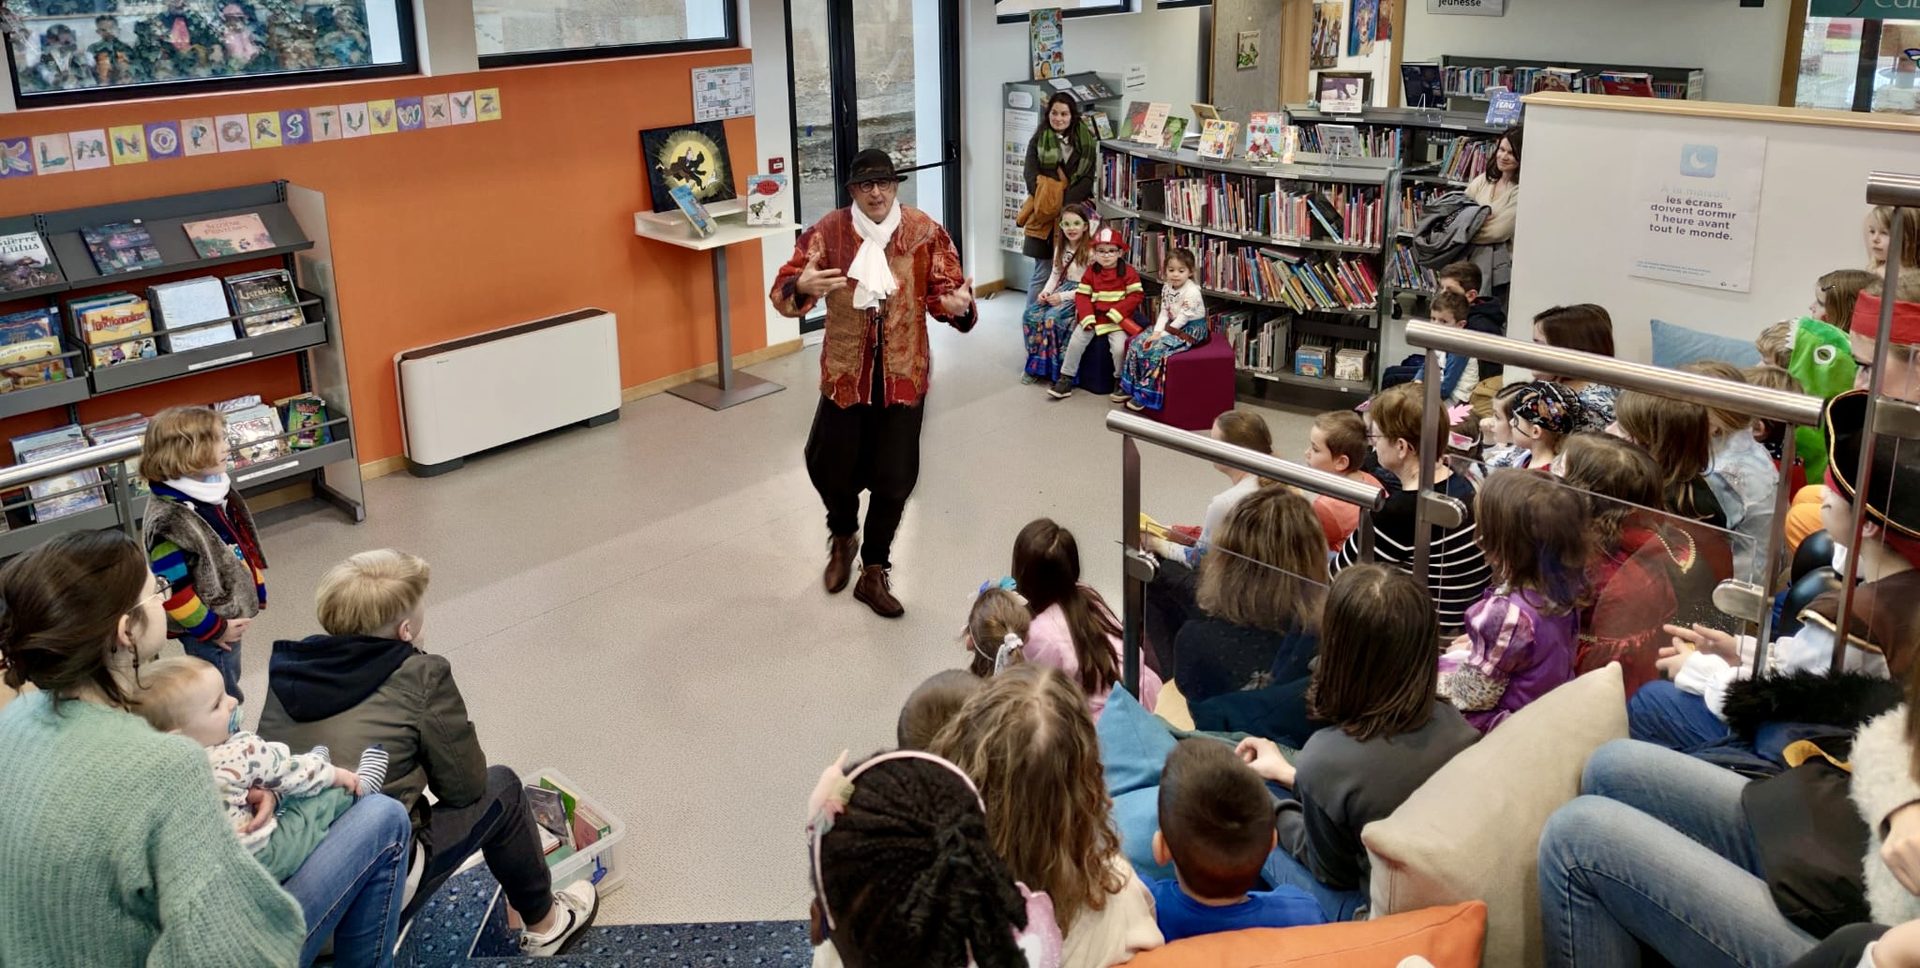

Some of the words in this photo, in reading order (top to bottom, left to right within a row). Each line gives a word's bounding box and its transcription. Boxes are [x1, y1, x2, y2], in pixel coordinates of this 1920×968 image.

[40, 141, 69, 168] L
[75, 138, 106, 160] M
[115, 133, 142, 156] N
[151, 127, 178, 154] O
[191, 124, 208, 149] P
[222, 120, 246, 143] Q
[256, 118, 277, 139] R
[286, 113, 305, 139] S
[316, 110, 333, 136] T
[346, 110, 364, 132] U
[372, 107, 392, 128] V
[398, 104, 421, 126] W
[431, 103, 445, 120] X
[452, 95, 472, 119] Y
[479, 94, 498, 114] Z
[1666, 195, 1682, 205] les
[1650, 204, 1693, 214] doivent
[1697, 208, 1737, 219] dormir
[1654, 213, 1659, 221] 1
[1662, 214, 1694, 226] heure
[1698, 219, 1730, 230] avant
[1649, 223, 1672, 233] tout
[1676, 226, 1686, 235] le
[1689, 229, 1733, 240] monde.
